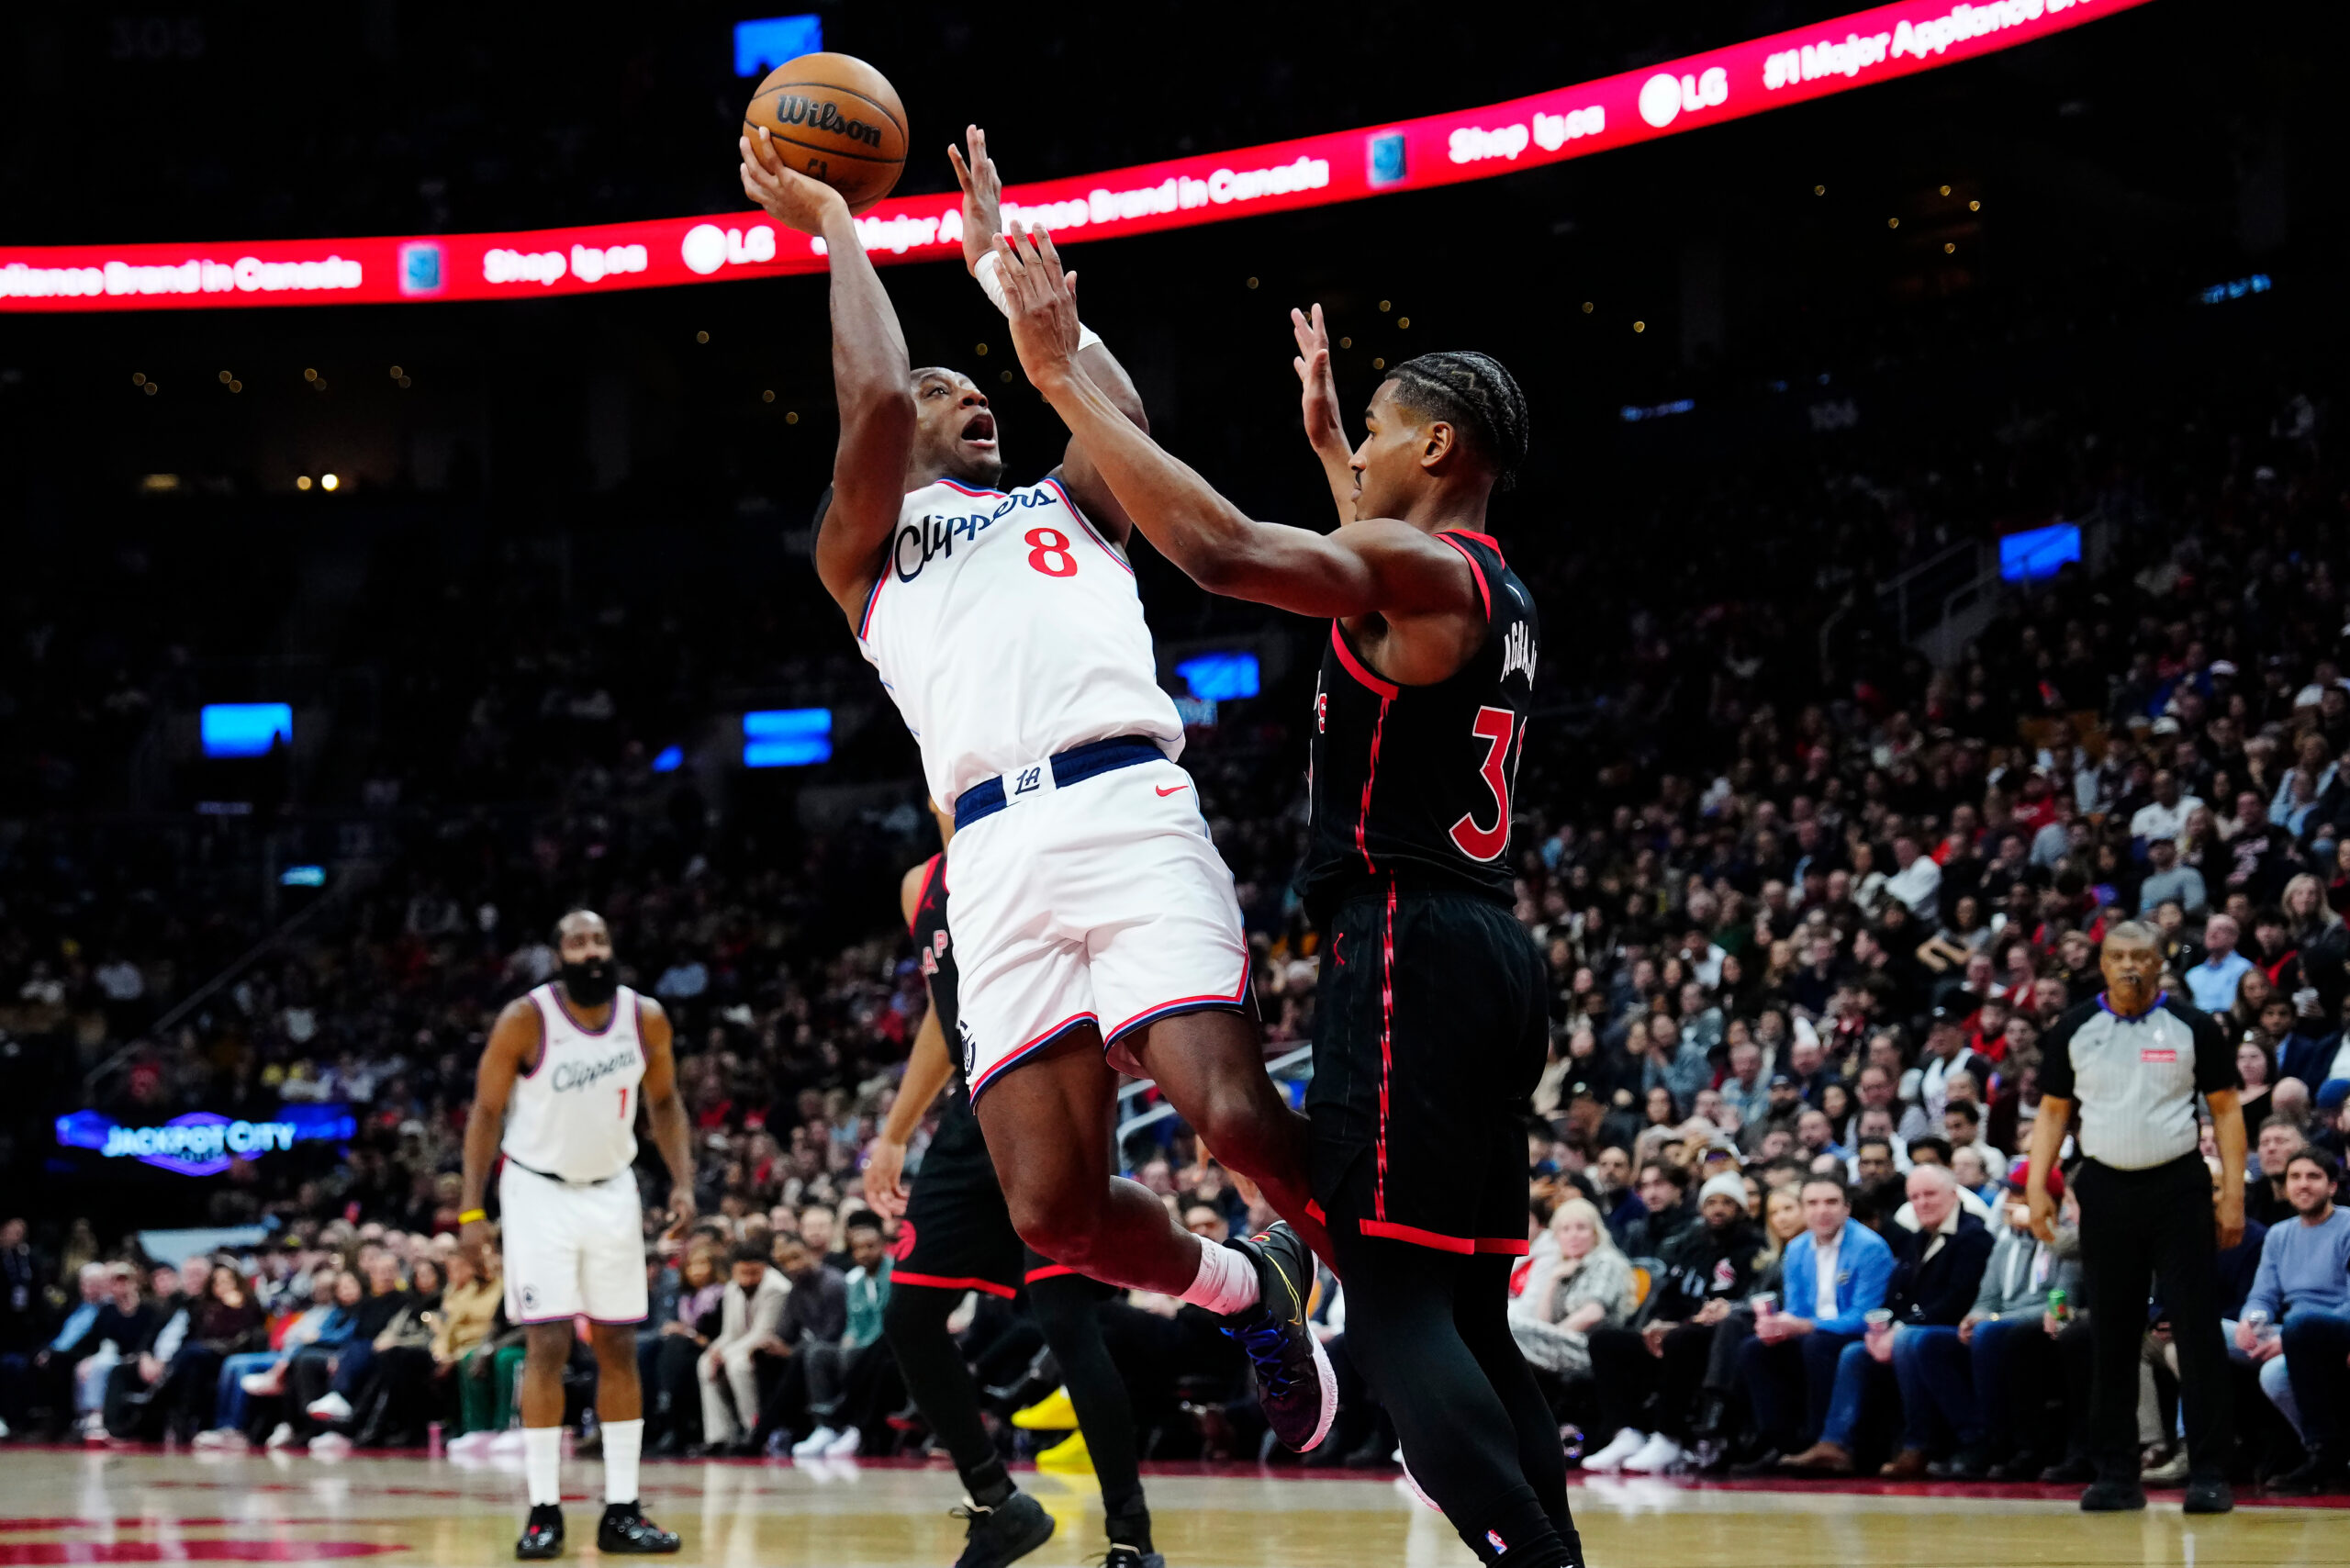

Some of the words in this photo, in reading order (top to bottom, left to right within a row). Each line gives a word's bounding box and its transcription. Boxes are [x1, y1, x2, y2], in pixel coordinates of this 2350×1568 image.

[1801, 33, 1891, 80] Major
[1891, 0, 2043, 59] Appliance
[1681, 67, 1728, 111] LG
[778, 94, 882, 149] Wilson
[727, 225, 776, 264] LG
[894, 488, 1057, 584] Clippers
[1024, 527, 1078, 577] 8
[1449, 704, 1528, 863] 3
[552, 1049, 636, 1092] Clippers
[618, 1088, 628, 1119] 1
[101, 1124, 226, 1159] JACKPOT
[225, 1120, 297, 1152] CITY
